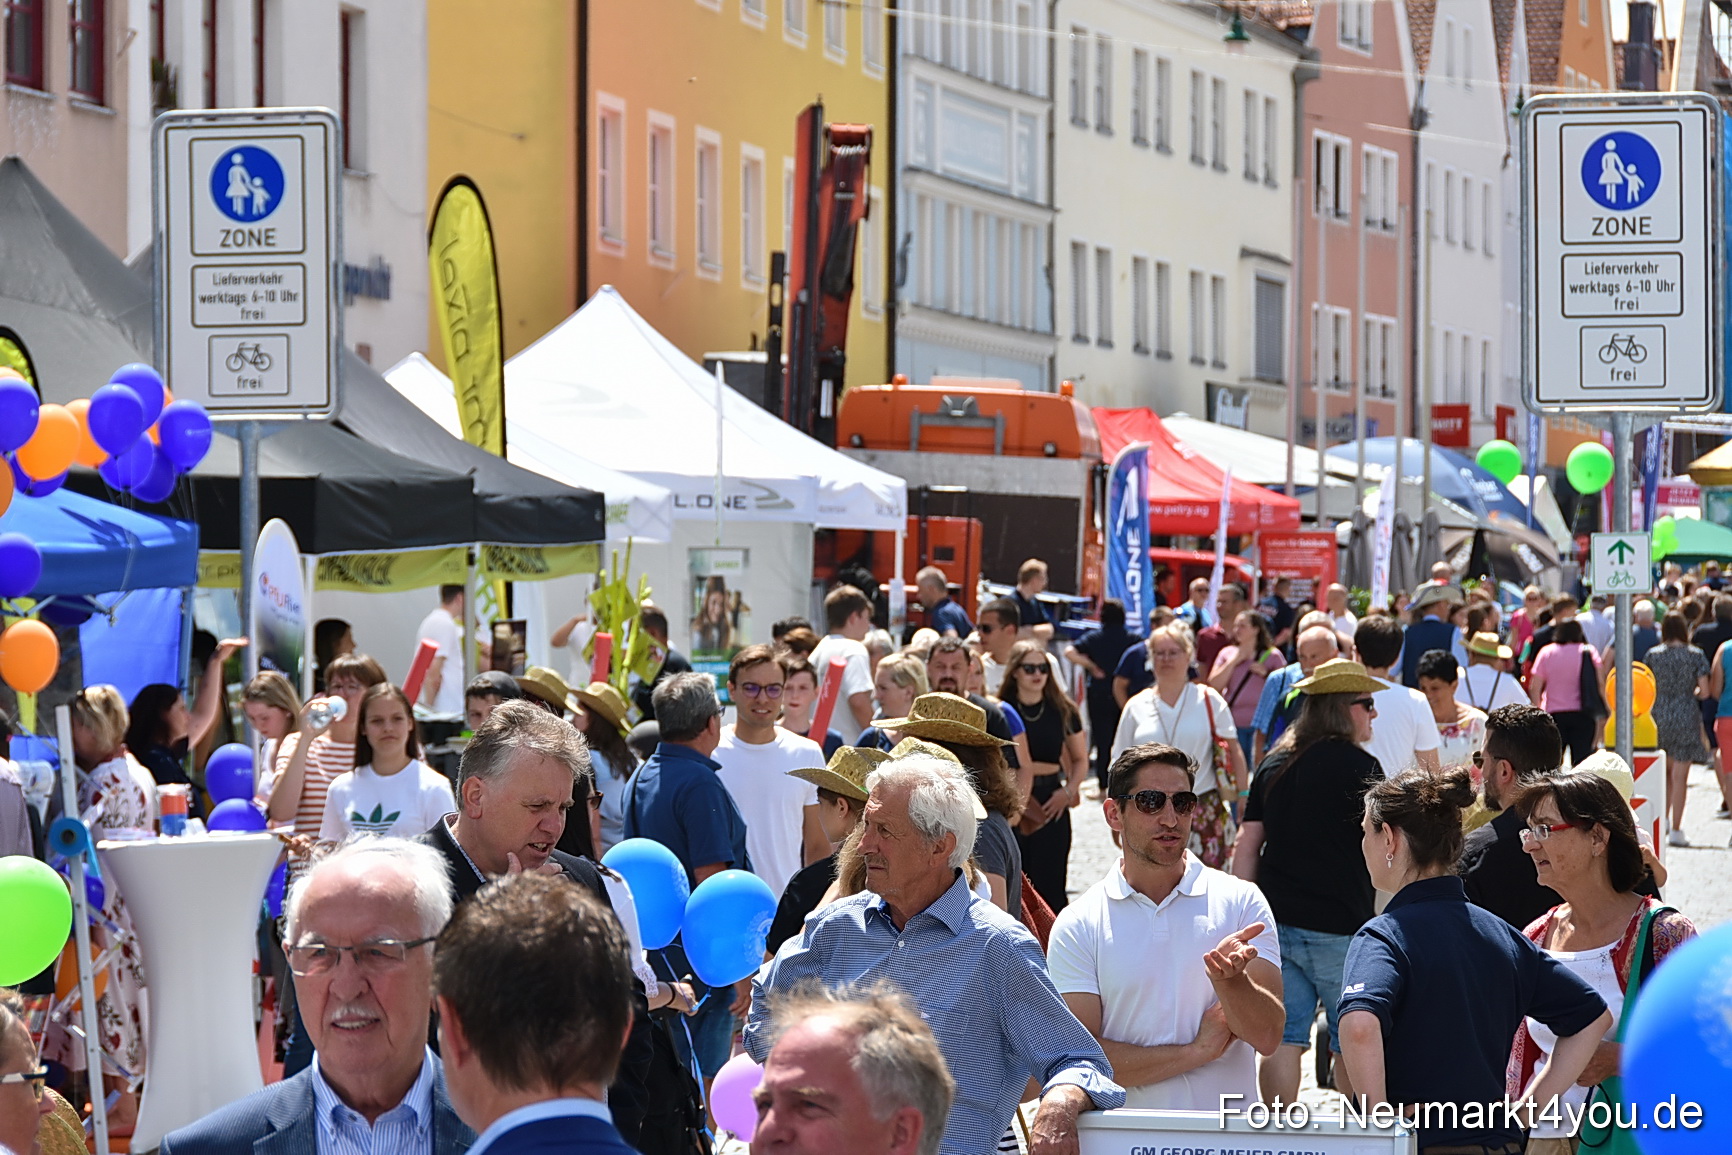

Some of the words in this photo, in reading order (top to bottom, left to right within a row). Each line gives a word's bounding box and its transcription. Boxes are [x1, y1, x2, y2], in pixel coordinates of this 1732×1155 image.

[1592, 216, 1652, 236] ZONE
[219, 228, 276, 247] ZONE
[1584, 261, 1659, 275] Lieferverkehr
[212, 272, 283, 286] Lieferverkehr
[1569, 281, 1620, 296] werktags
[1626, 280, 1651, 293] 6-10
[1656, 279, 1675, 292] Uhr
[198, 292, 246, 305] werktags
[251, 290, 275, 303] 6-10
[280, 288, 298, 302] Uhr
[1614, 297, 1639, 310] frei
[240, 307, 265, 320] frei
[1610, 366, 1637, 381] frei
[236, 375, 262, 389] frei
